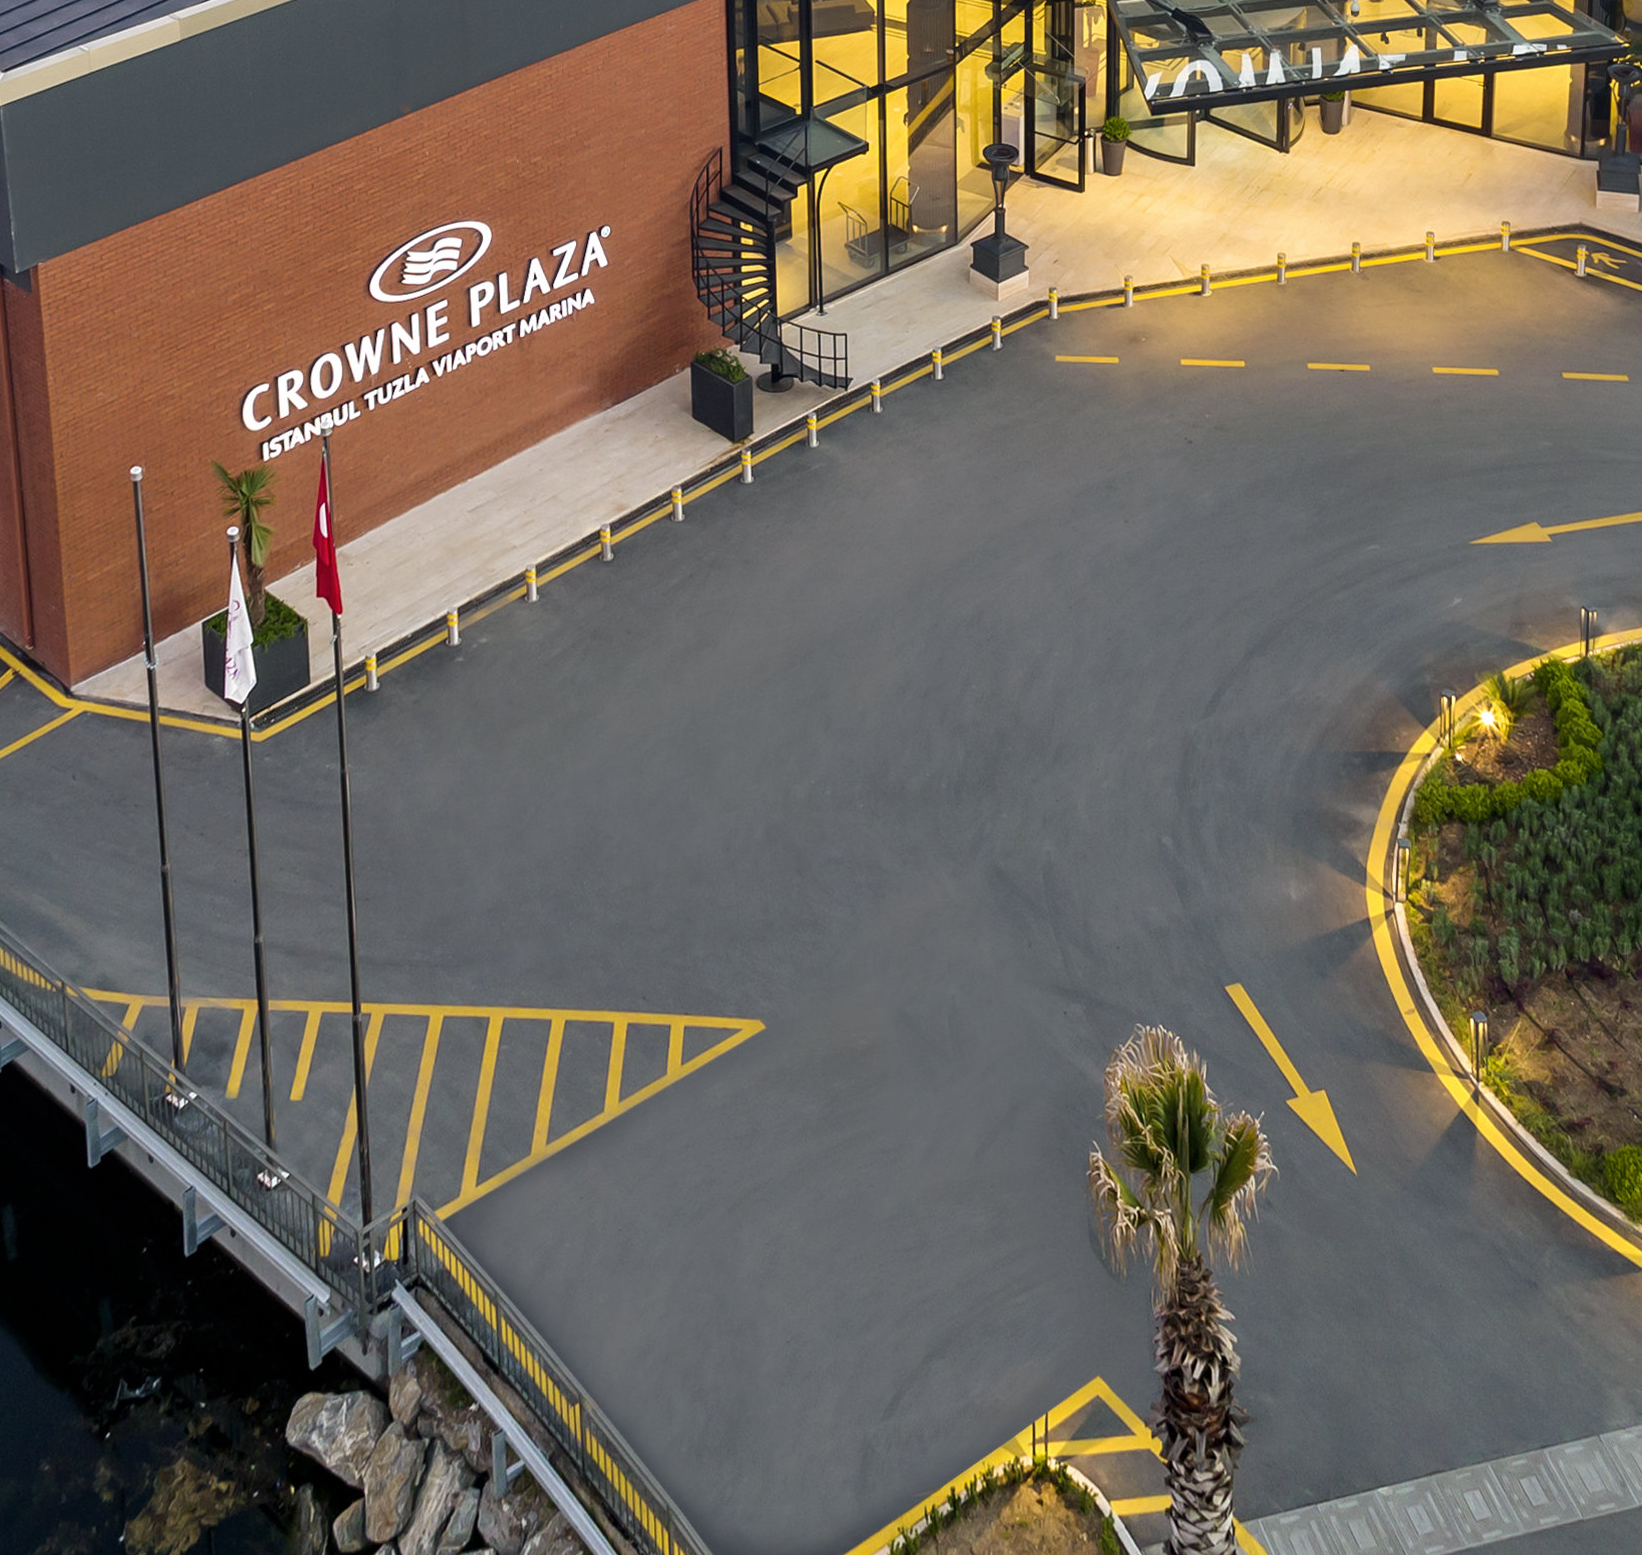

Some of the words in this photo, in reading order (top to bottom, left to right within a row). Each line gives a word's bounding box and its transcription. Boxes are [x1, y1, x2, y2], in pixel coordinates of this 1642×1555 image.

[241, 299, 450, 431] CROWNE
[261, 400, 361, 461] ISTANBUL
[364, 367, 430, 412] TUZLA
[432, 323, 517, 378] VIAPORT
[518, 288, 595, 338] MARINA
